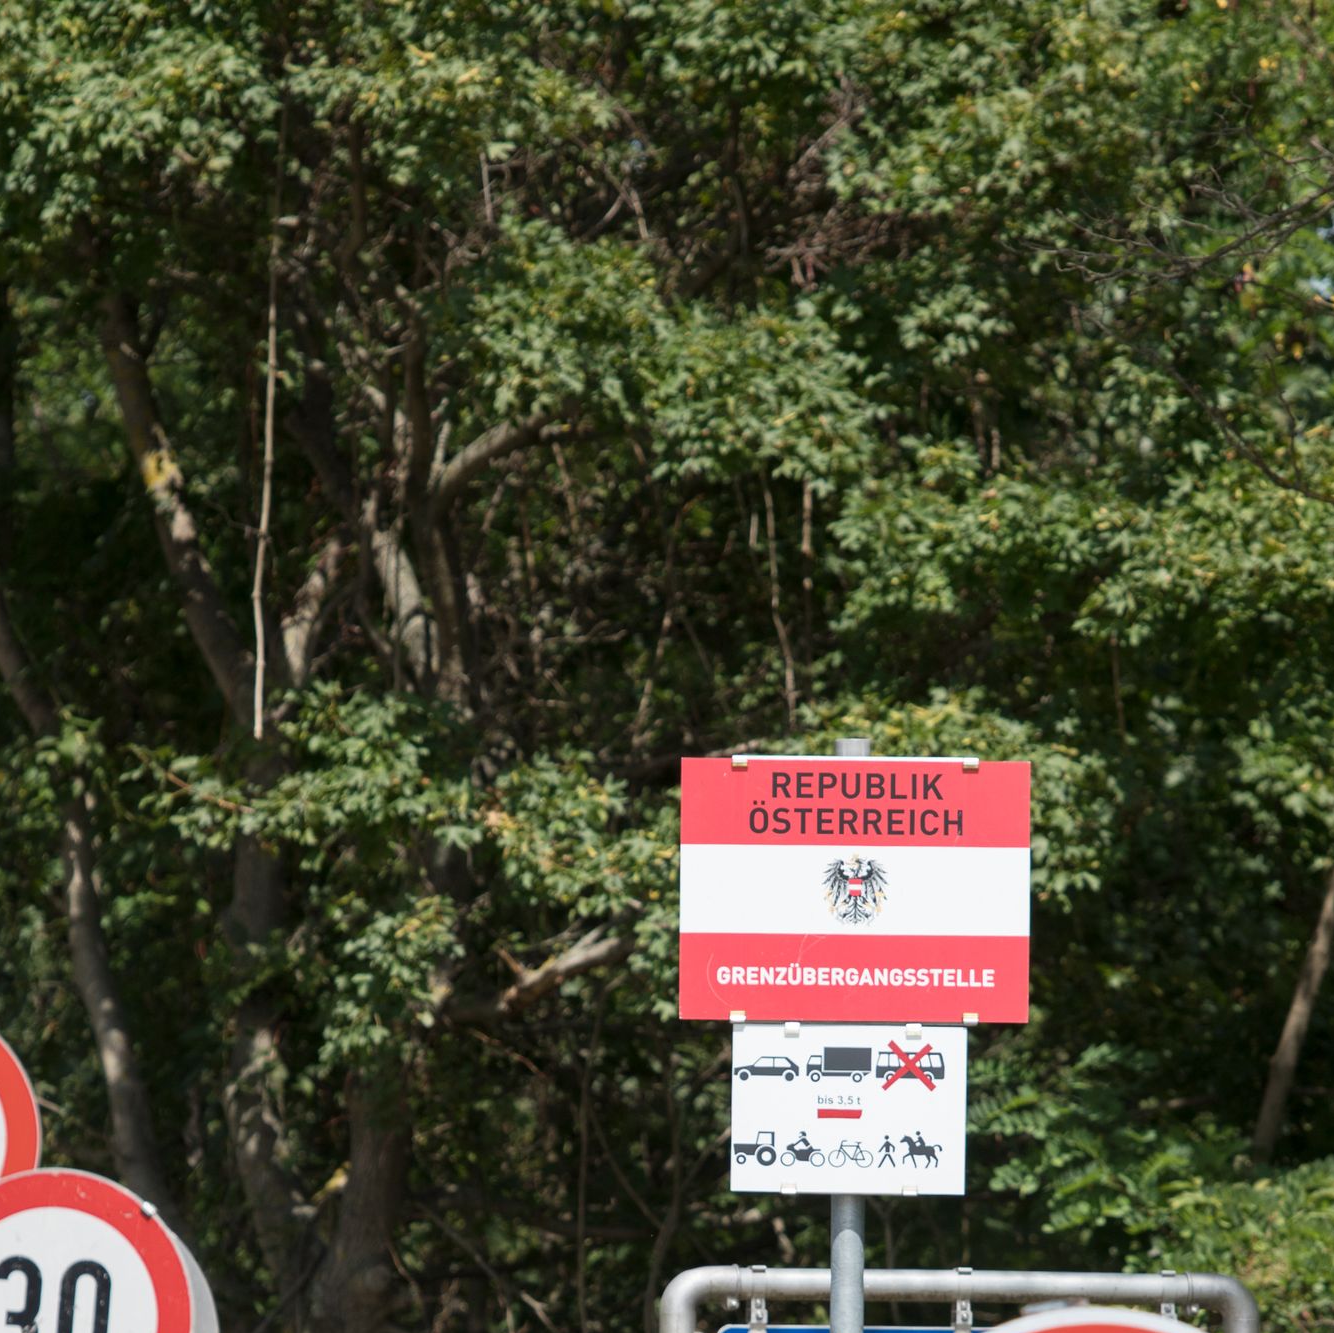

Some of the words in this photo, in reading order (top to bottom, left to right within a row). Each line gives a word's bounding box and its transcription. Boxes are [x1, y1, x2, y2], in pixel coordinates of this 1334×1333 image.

[771, 771, 944, 801] REPUBLIK
[748, 800, 964, 836] ÖSTERREICH
[715, 962, 996, 988] GRENZÜBERGANGSSTELLE
[817, 1095, 834, 1105] bis
[837, 1095, 854, 1106] 3,5
